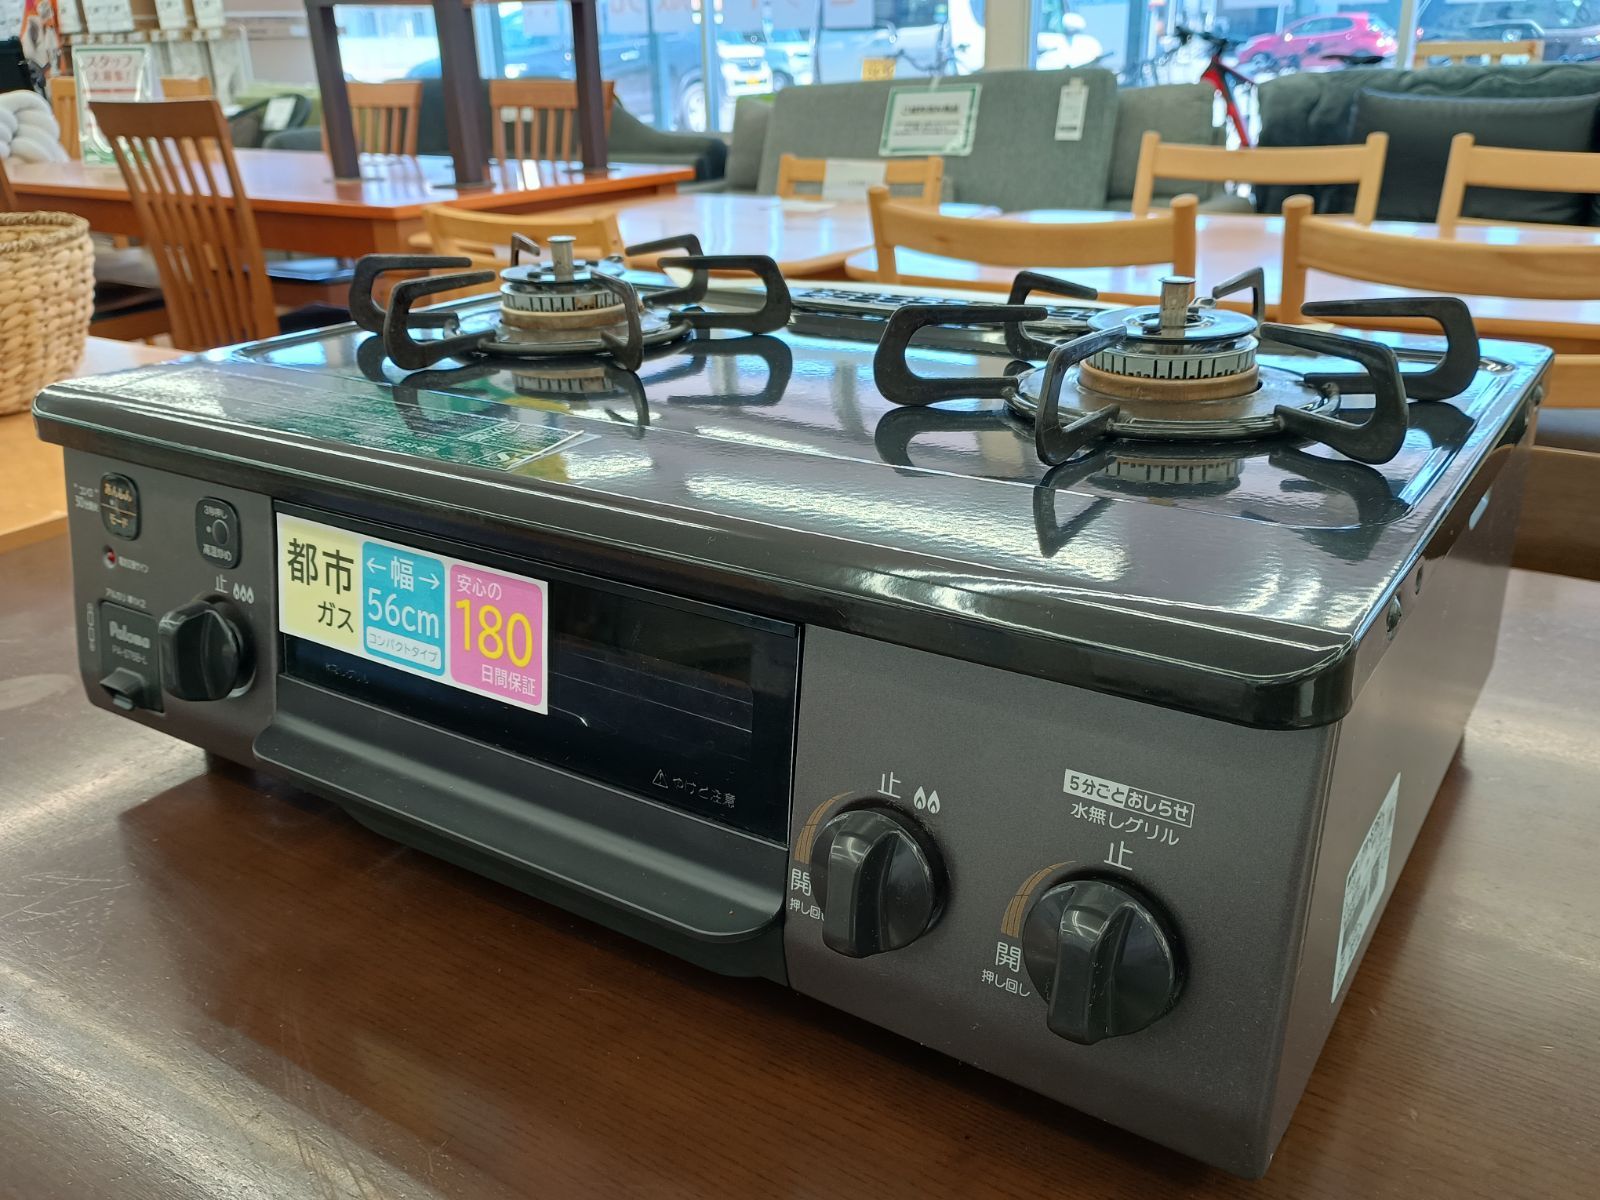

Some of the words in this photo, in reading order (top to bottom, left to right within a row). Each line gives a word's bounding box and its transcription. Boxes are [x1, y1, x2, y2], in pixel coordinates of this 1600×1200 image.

[287, 537, 355, 595] 都市
[390, 555, 415, 592] 幅
[214, 574, 229, 594] 止
[456, 574, 502, 601] 安心の
[317, 601, 355, 633] ガス
[366, 587, 440, 639] 56cm
[368, 632, 439, 662] コンパクトタイプ
[455, 598, 533, 669] 180
[481, 663, 536, 698] 日間保証
[876, 771, 902, 799] 止
[1070, 801, 1180, 846] 水無しグリル
[1103, 840, 1134, 871] 止
[994, 941, 1022, 973] 開
[981, 968, 1031, 998] 押し回し
